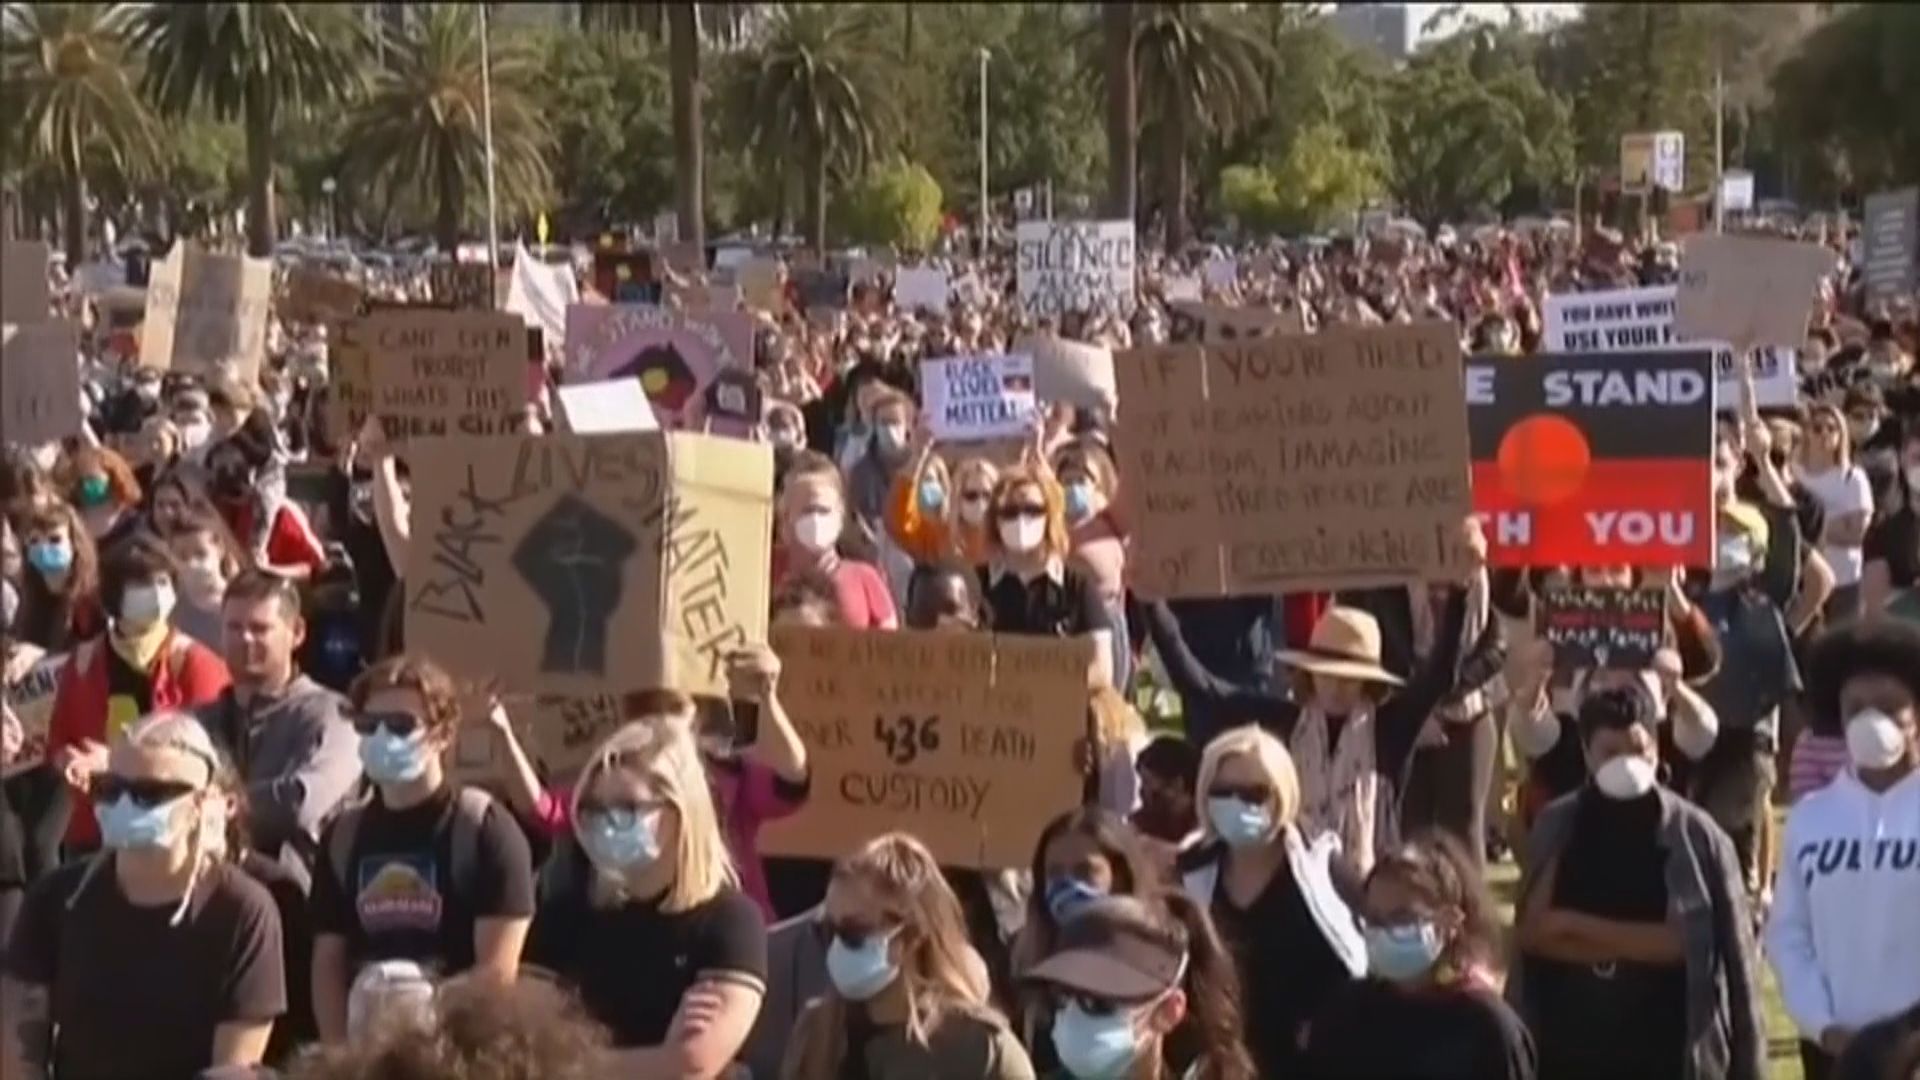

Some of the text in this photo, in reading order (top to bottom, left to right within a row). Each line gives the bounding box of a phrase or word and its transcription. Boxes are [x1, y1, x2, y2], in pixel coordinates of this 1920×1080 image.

[1564, 331, 1598, 349] USE
[1605, 326, 1657, 347] YOUR
[1140, 352, 1178, 389] IF
[1465, 365, 1704, 406] E STAND
[1584, 510, 1694, 546] YOU
[410, 464, 505, 624] BLACK
[643, 497, 748, 682] MATTER
[874, 714, 942, 766] 436
[960, 722, 1037, 760] DEATH
[838, 770, 992, 820] CUSTODY
[1797, 836, 1919, 890] CULTU
